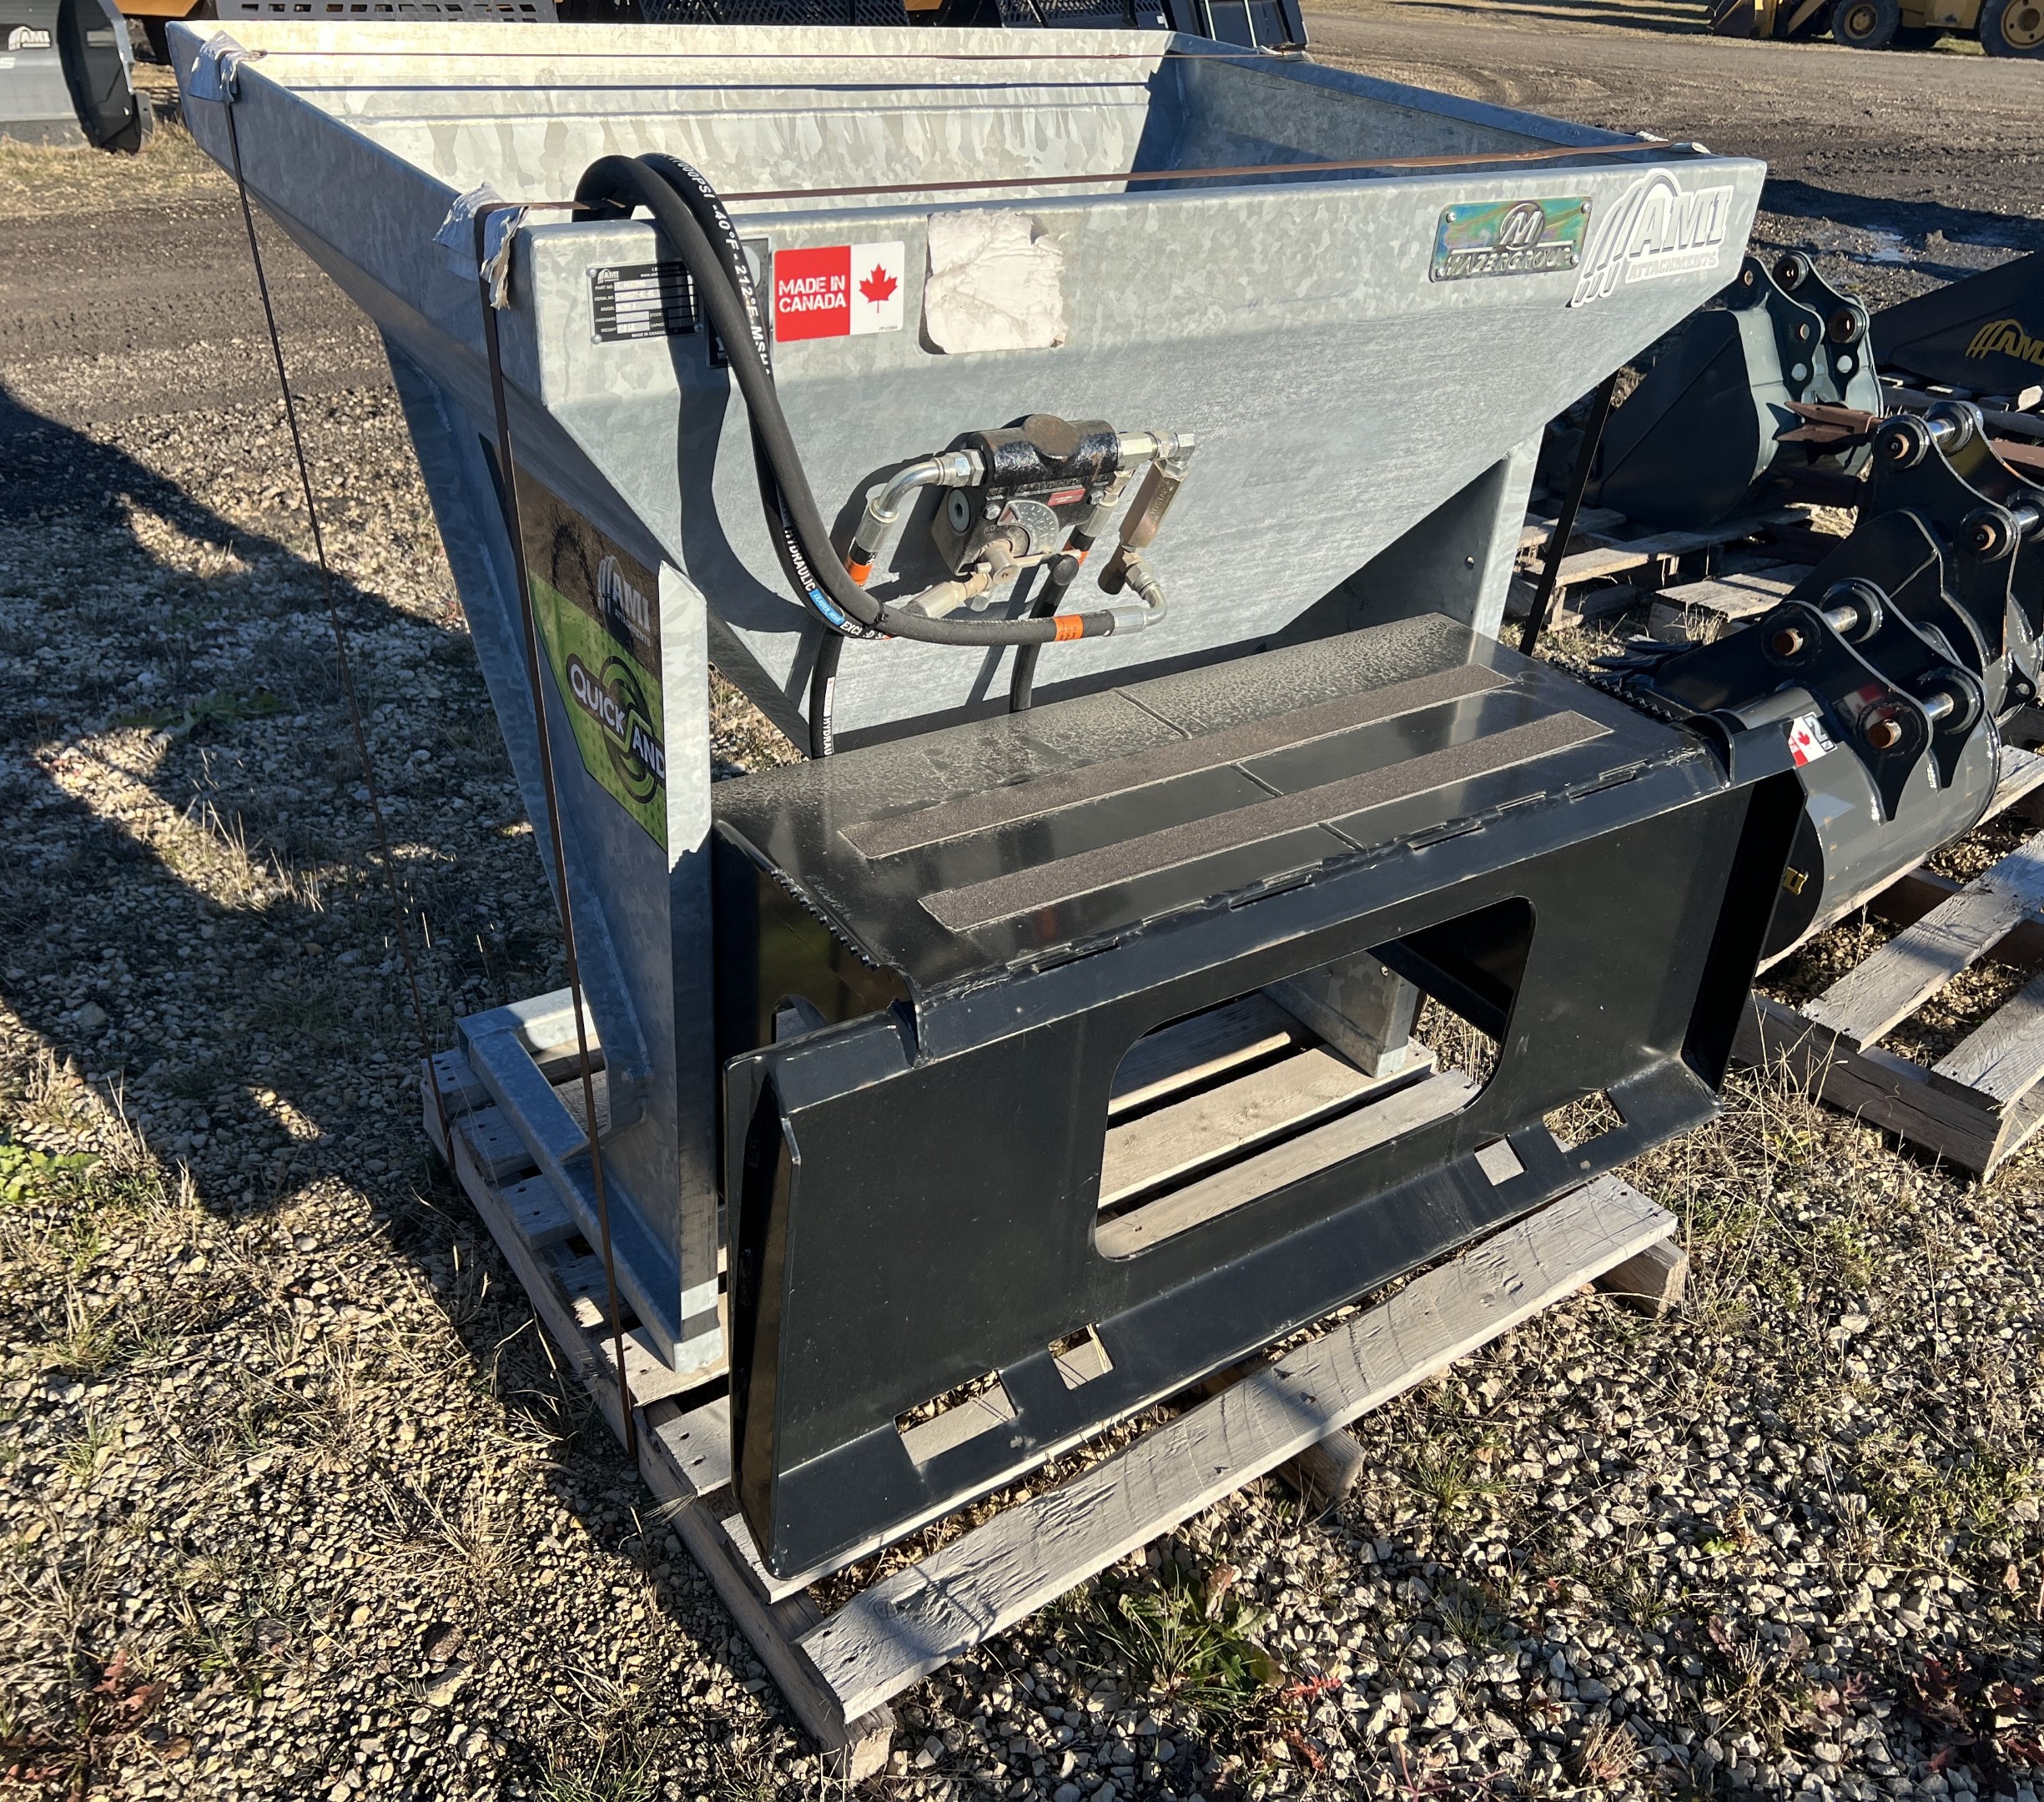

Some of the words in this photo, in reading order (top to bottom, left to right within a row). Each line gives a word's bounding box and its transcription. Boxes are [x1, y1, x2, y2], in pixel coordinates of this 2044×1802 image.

[1629, 189, 1732, 259] AMI
[778, 276, 827, 296] MADE
[830, 274, 846, 291] IN
[1628, 250, 1717, 280] ATTACHMENTS
[778, 292, 847, 314] CANADA
[613, 572, 651, 632] AMI
[570, 663, 625, 737] QUICK
[632, 726, 666, 780] AND
